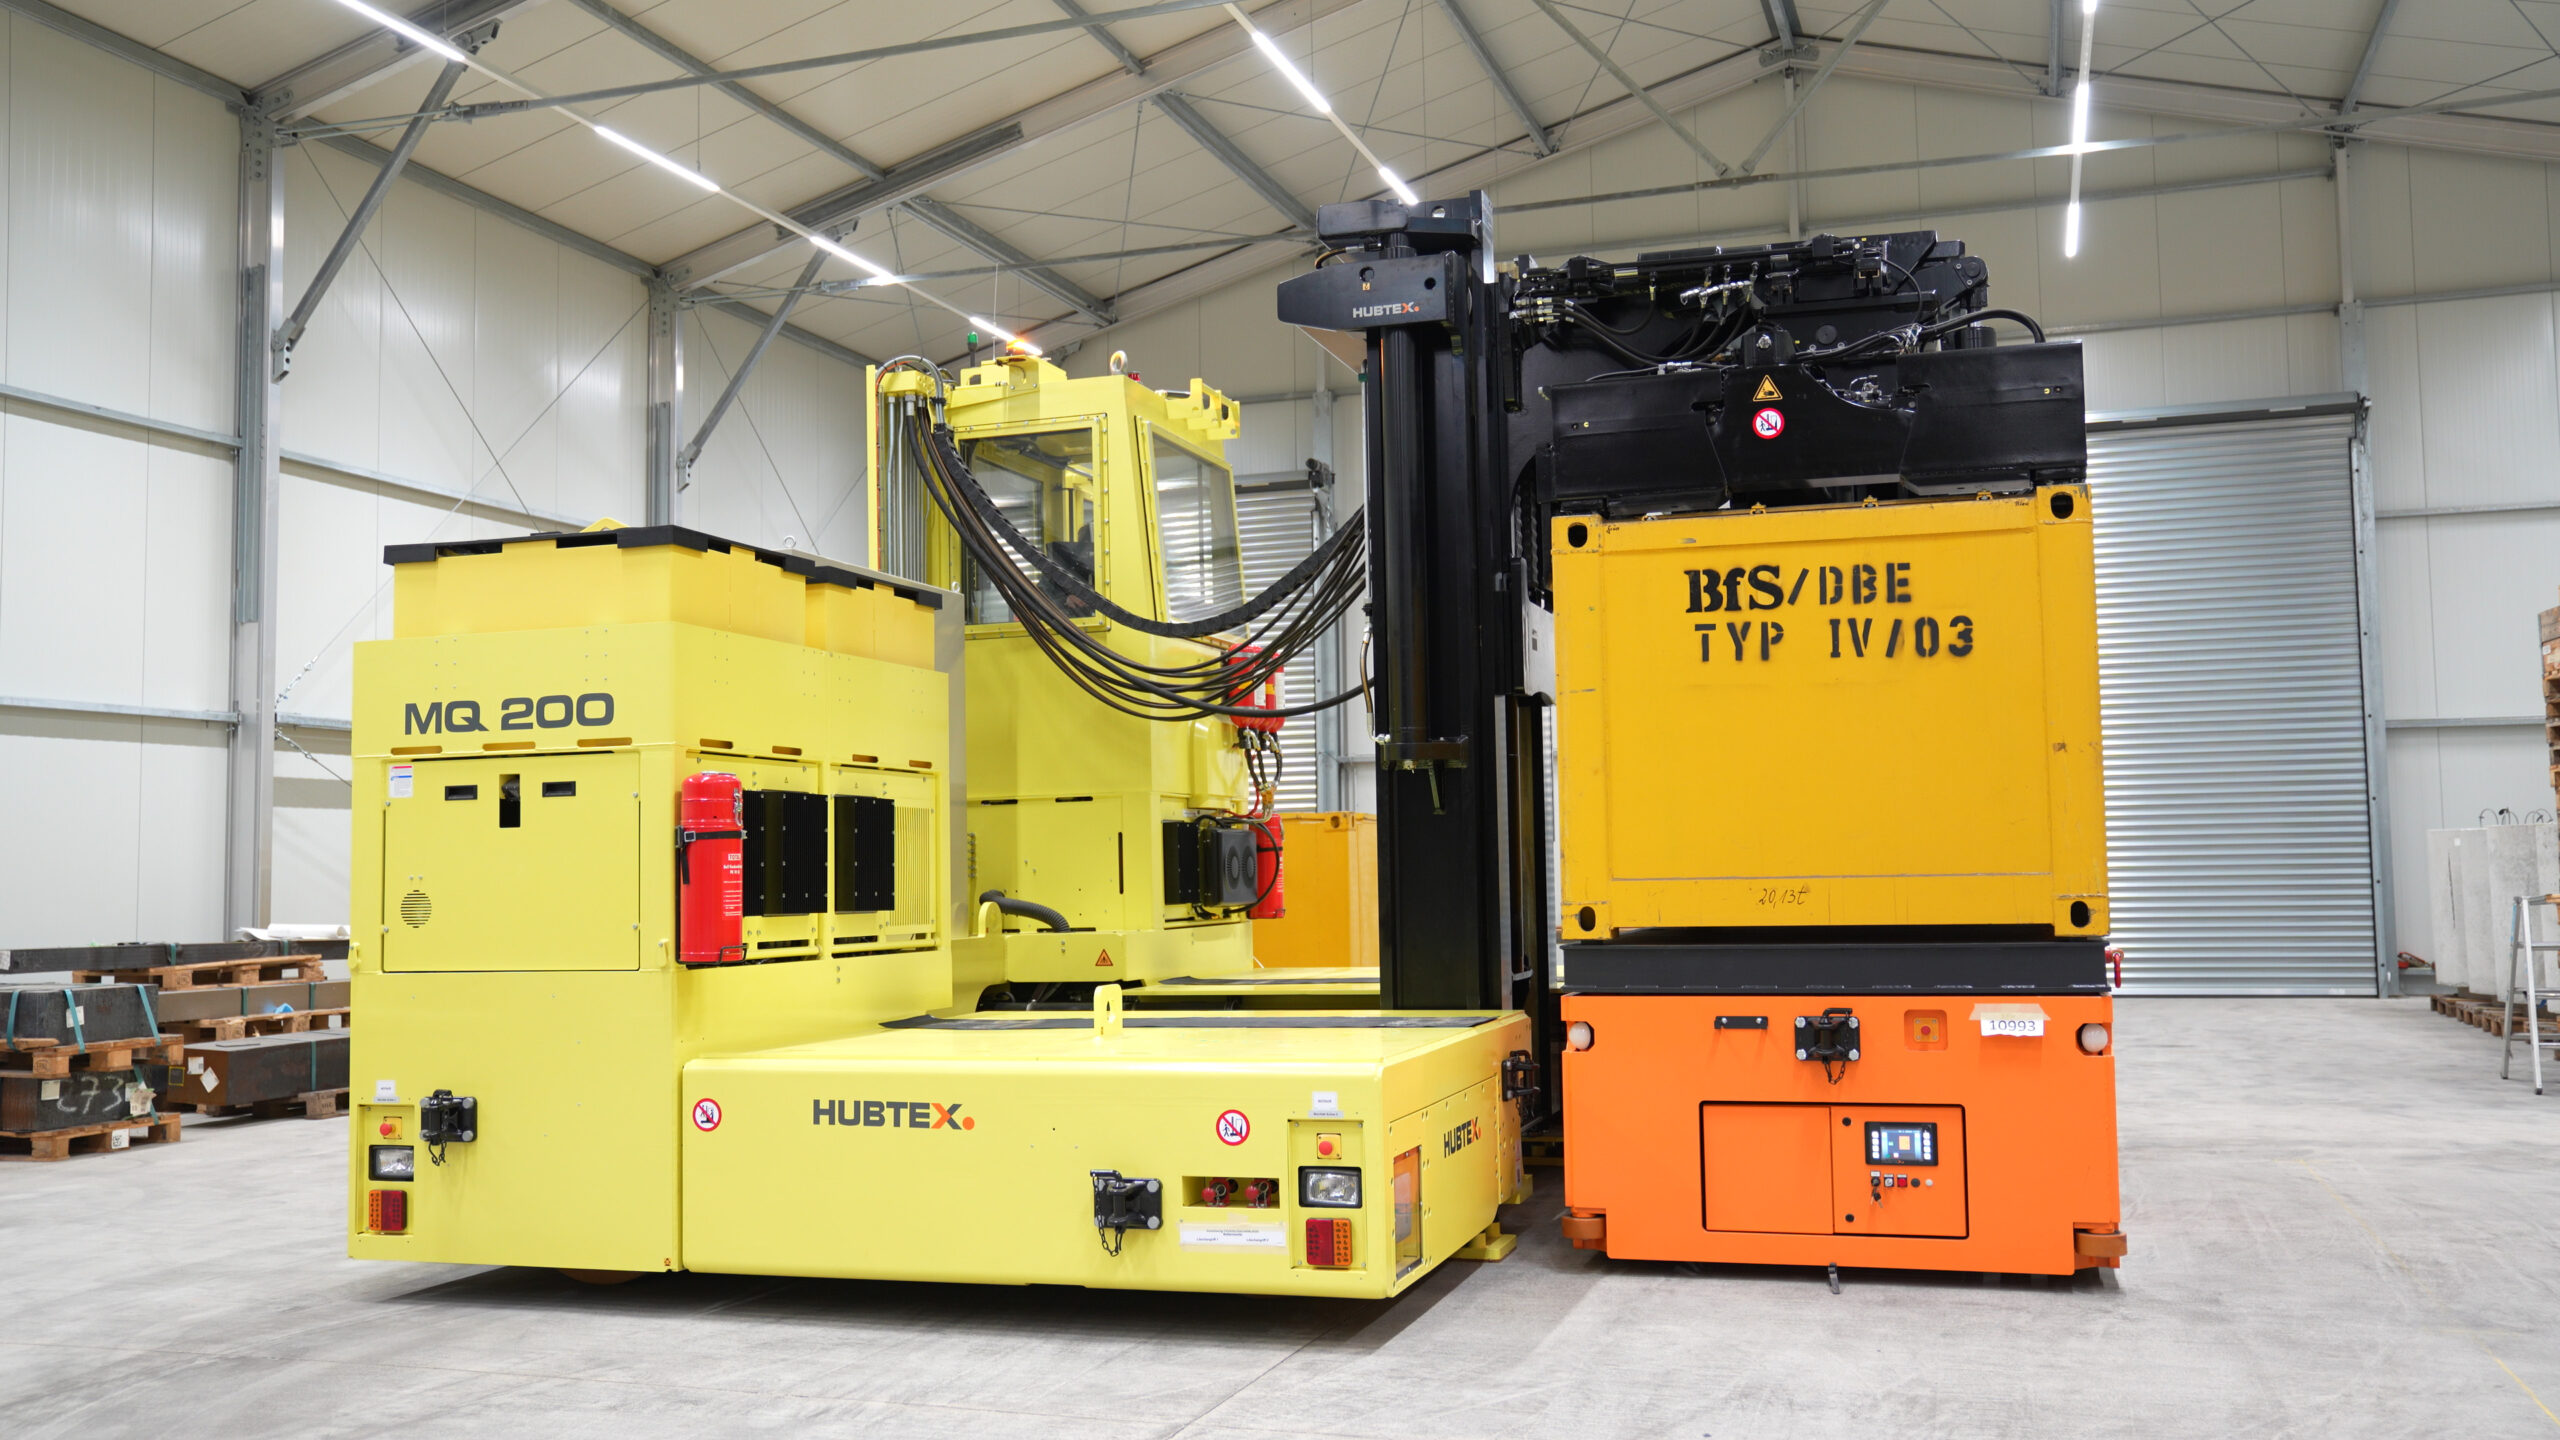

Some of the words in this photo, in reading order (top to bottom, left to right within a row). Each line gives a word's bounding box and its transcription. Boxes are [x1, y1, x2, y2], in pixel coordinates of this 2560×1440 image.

[1694, 620, 1784, 662] TYP
[1828, 614, 1974, 658] IV/03
[404, 700, 489, 736] MQ
[500, 692, 615, 731] 200
[1989, 1019, 2036, 1032] 10993
